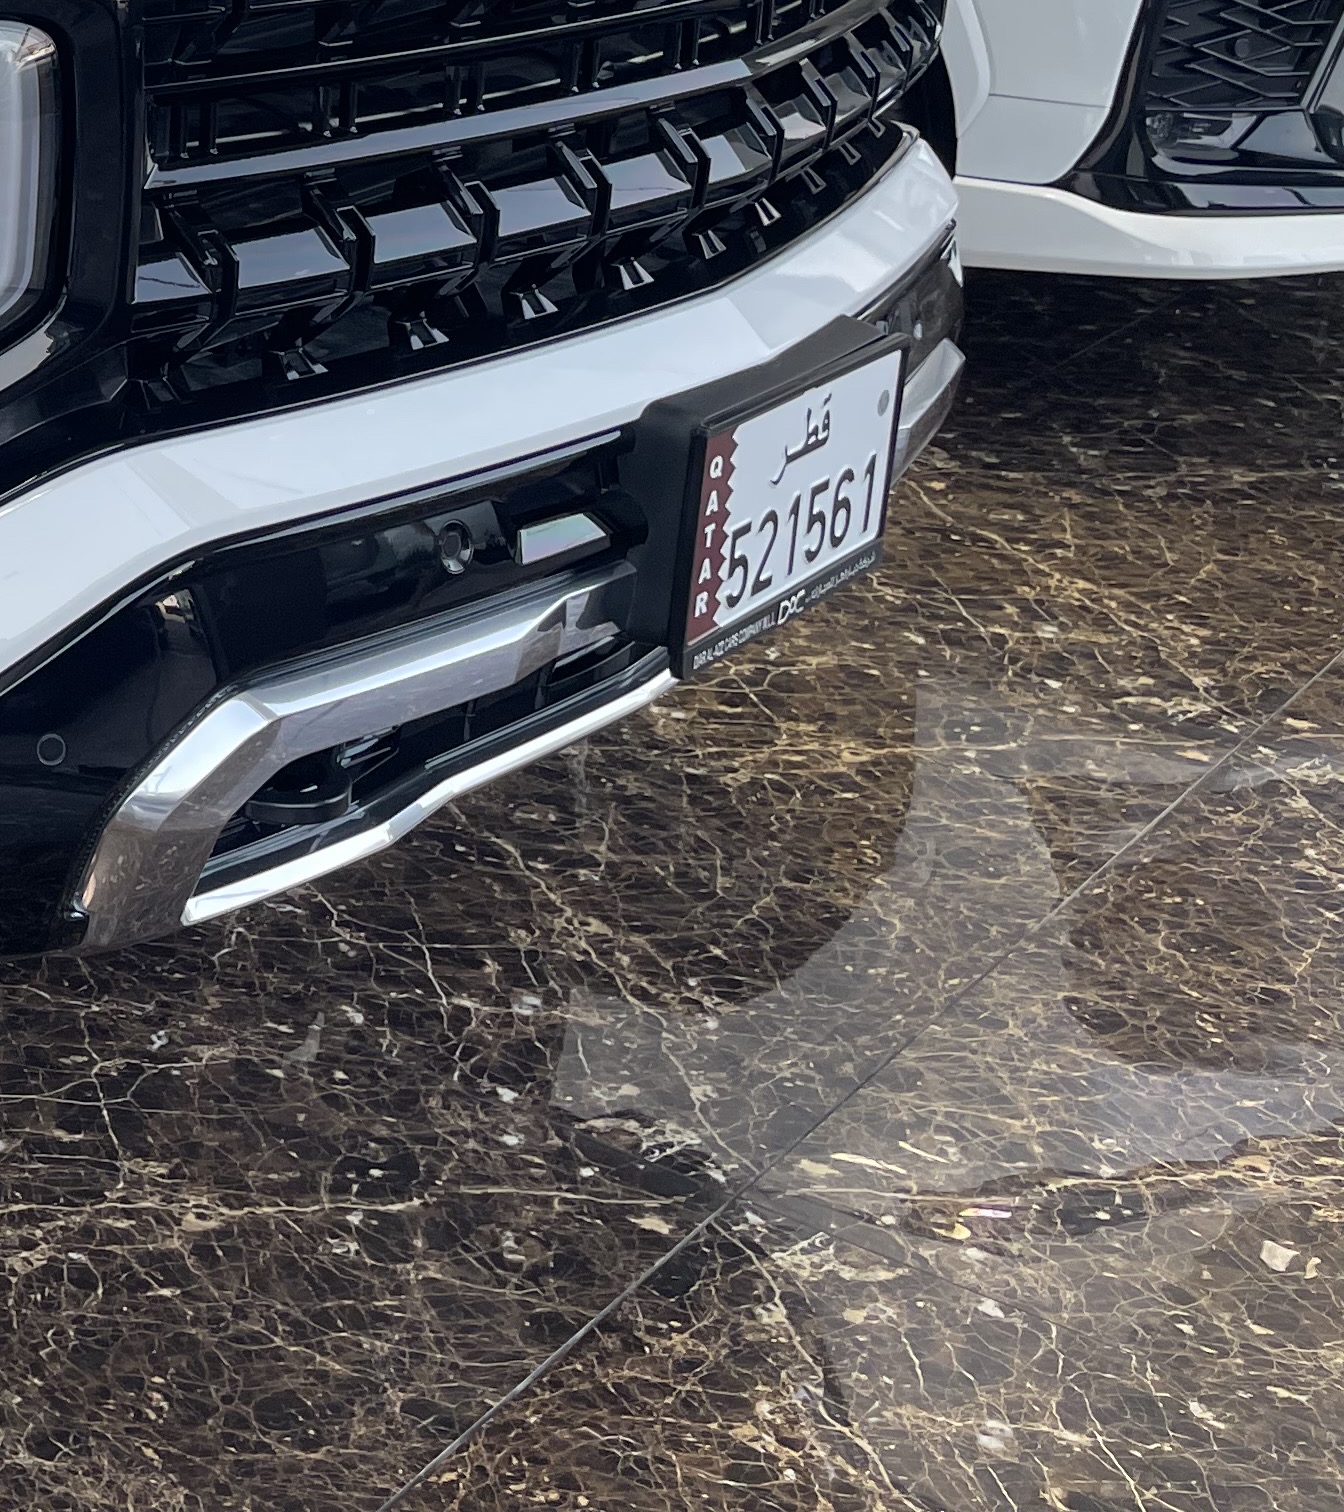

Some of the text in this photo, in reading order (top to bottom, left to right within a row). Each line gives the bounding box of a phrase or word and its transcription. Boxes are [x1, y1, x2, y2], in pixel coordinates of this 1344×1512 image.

[768, 391, 832, 486] قطر
[694, 455, 724, 619] QATAR
[723, 451, 878, 610] 521561
